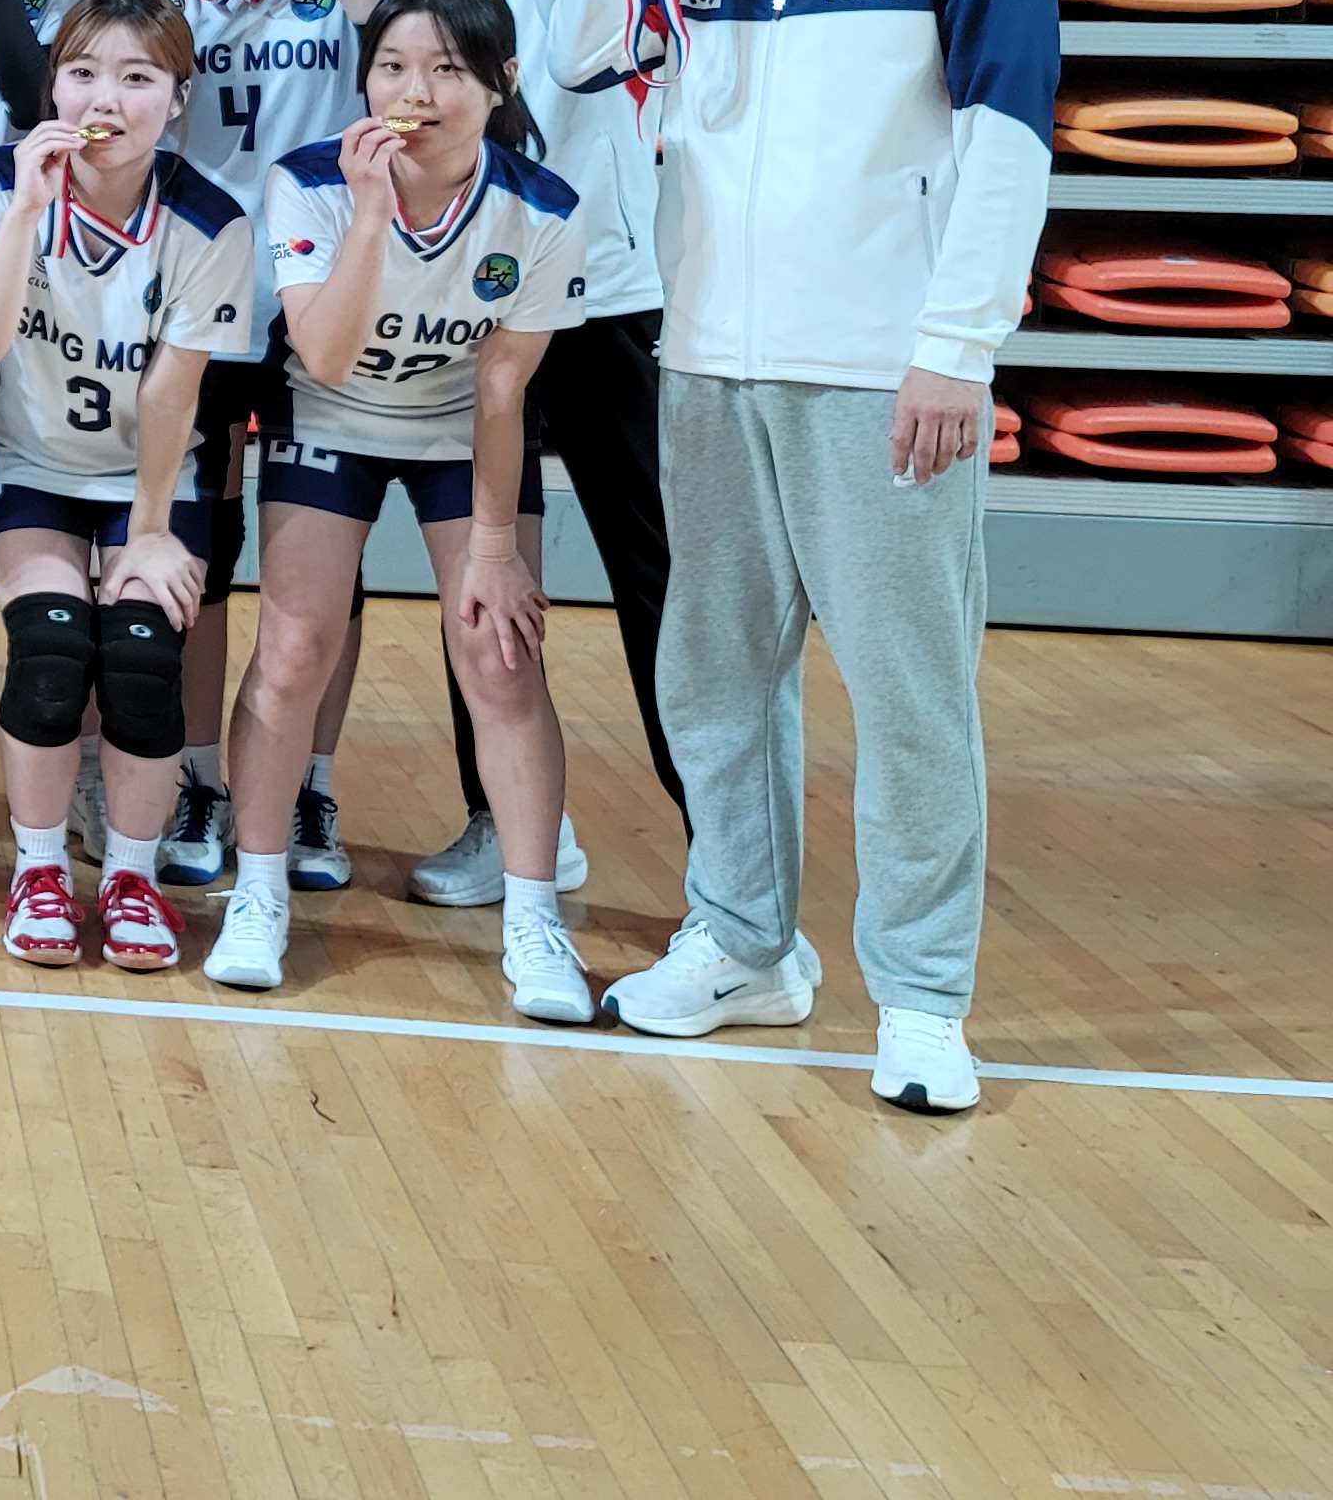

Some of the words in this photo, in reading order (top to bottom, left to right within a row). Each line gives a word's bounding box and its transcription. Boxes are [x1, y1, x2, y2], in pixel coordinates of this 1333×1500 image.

[243, 38, 340, 72] MOON
[218, 85, 261, 151] 4
[413, 313, 494, 346] MOO
[66, 375, 112, 432] 3
